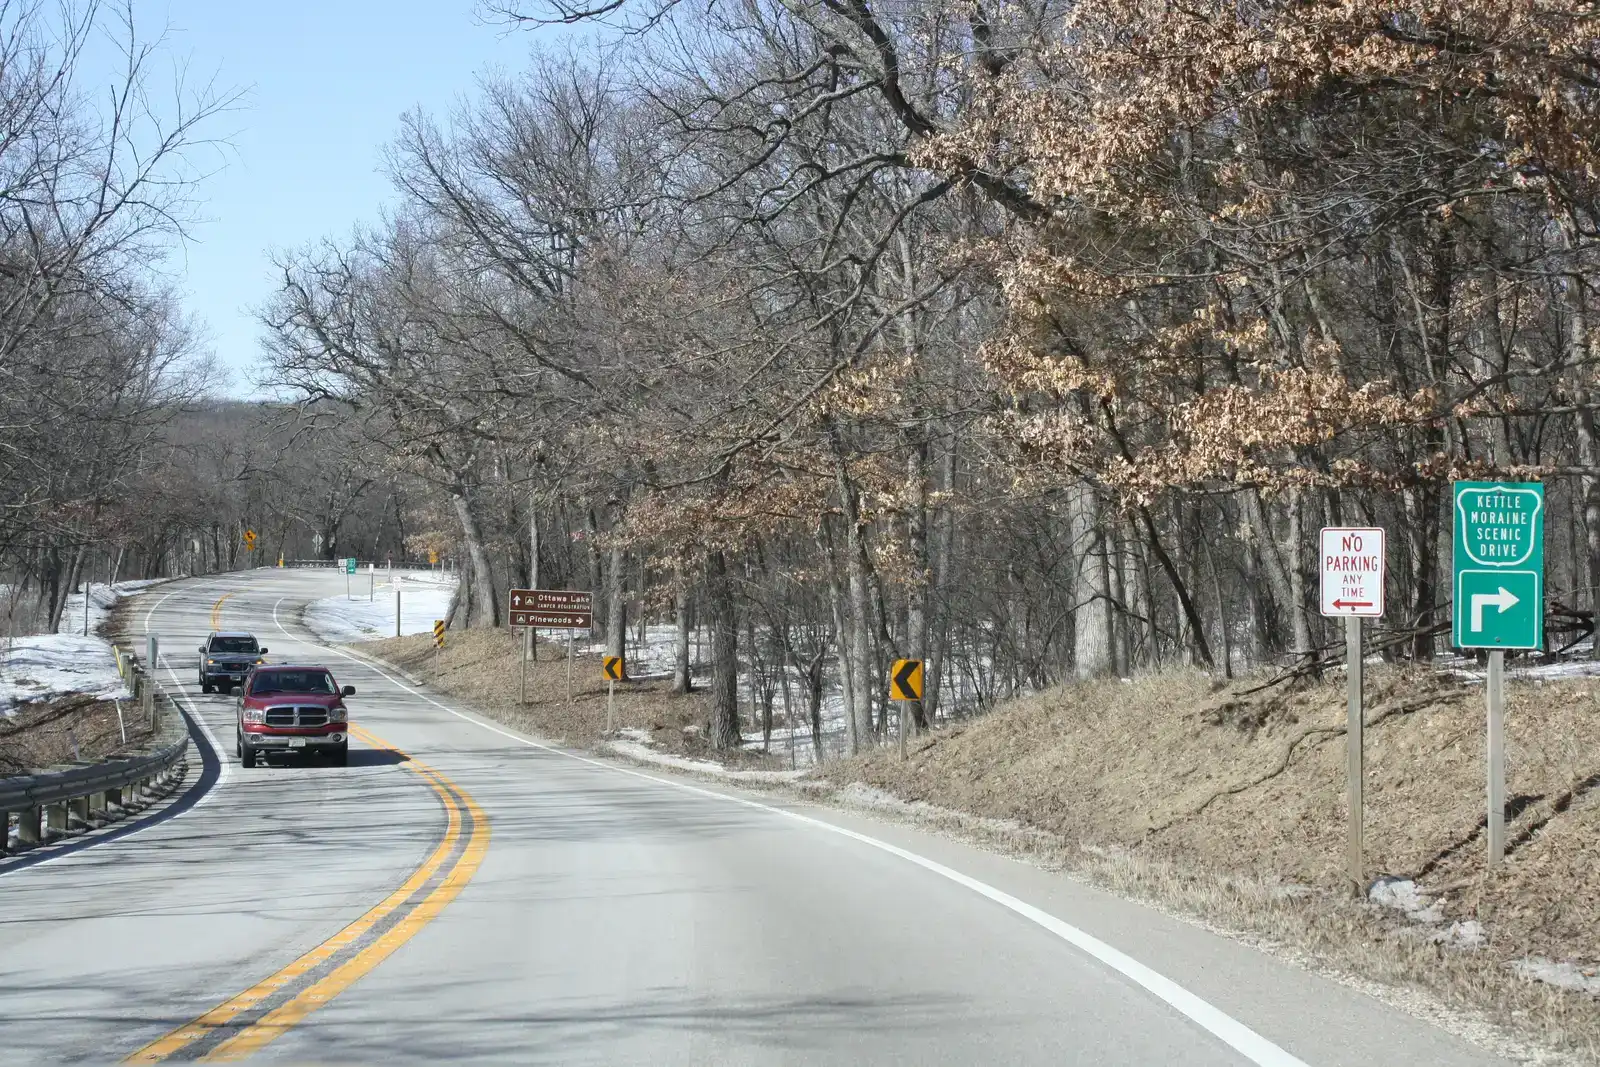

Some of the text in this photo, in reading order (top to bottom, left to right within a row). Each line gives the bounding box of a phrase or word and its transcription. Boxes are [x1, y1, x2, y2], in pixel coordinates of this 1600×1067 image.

[1477, 495, 1521, 509] KETTLE
[1471, 511, 1527, 525] MORAINE
[1477, 527, 1521, 541] SCENIC
[1342, 536, 1363, 552] NO
[1480, 543, 1517, 557] DRIVE
[1326, 555, 1378, 572] PARKING
[1342, 574, 1362, 585] ANY
[538, 594, 590, 603] Ottawa Lake
[1341, 587, 1365, 598] TIME
[529, 615, 572, 624] Pinewoods
